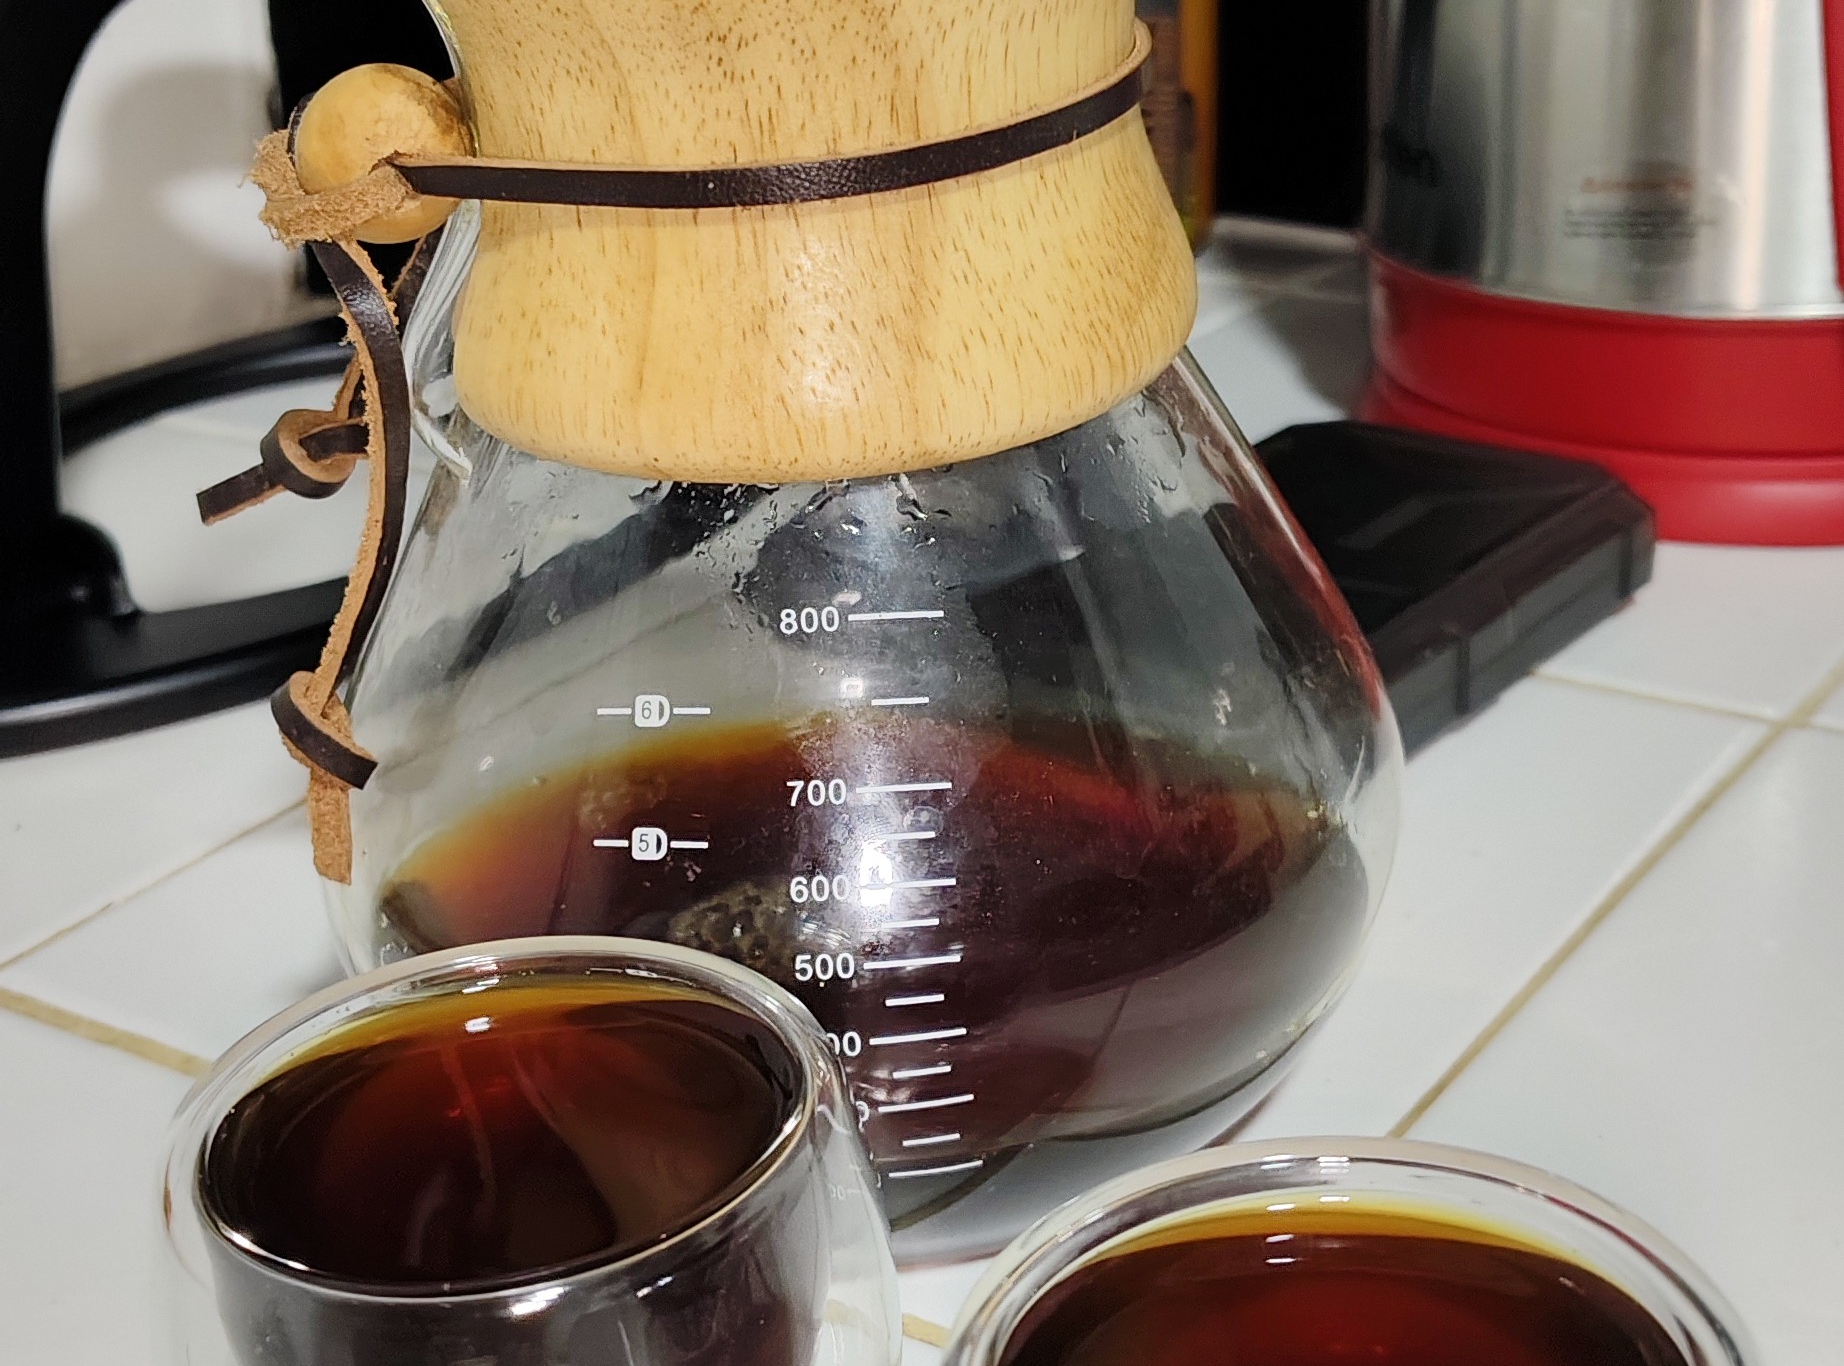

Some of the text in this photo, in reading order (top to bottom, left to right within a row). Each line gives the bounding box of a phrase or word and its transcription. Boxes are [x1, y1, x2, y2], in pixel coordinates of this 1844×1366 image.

[780, 606, 840, 634] 800
[786, 779, 846, 807] 700
[790, 875, 850, 903] 600
[795, 953, 855, 981] 500
